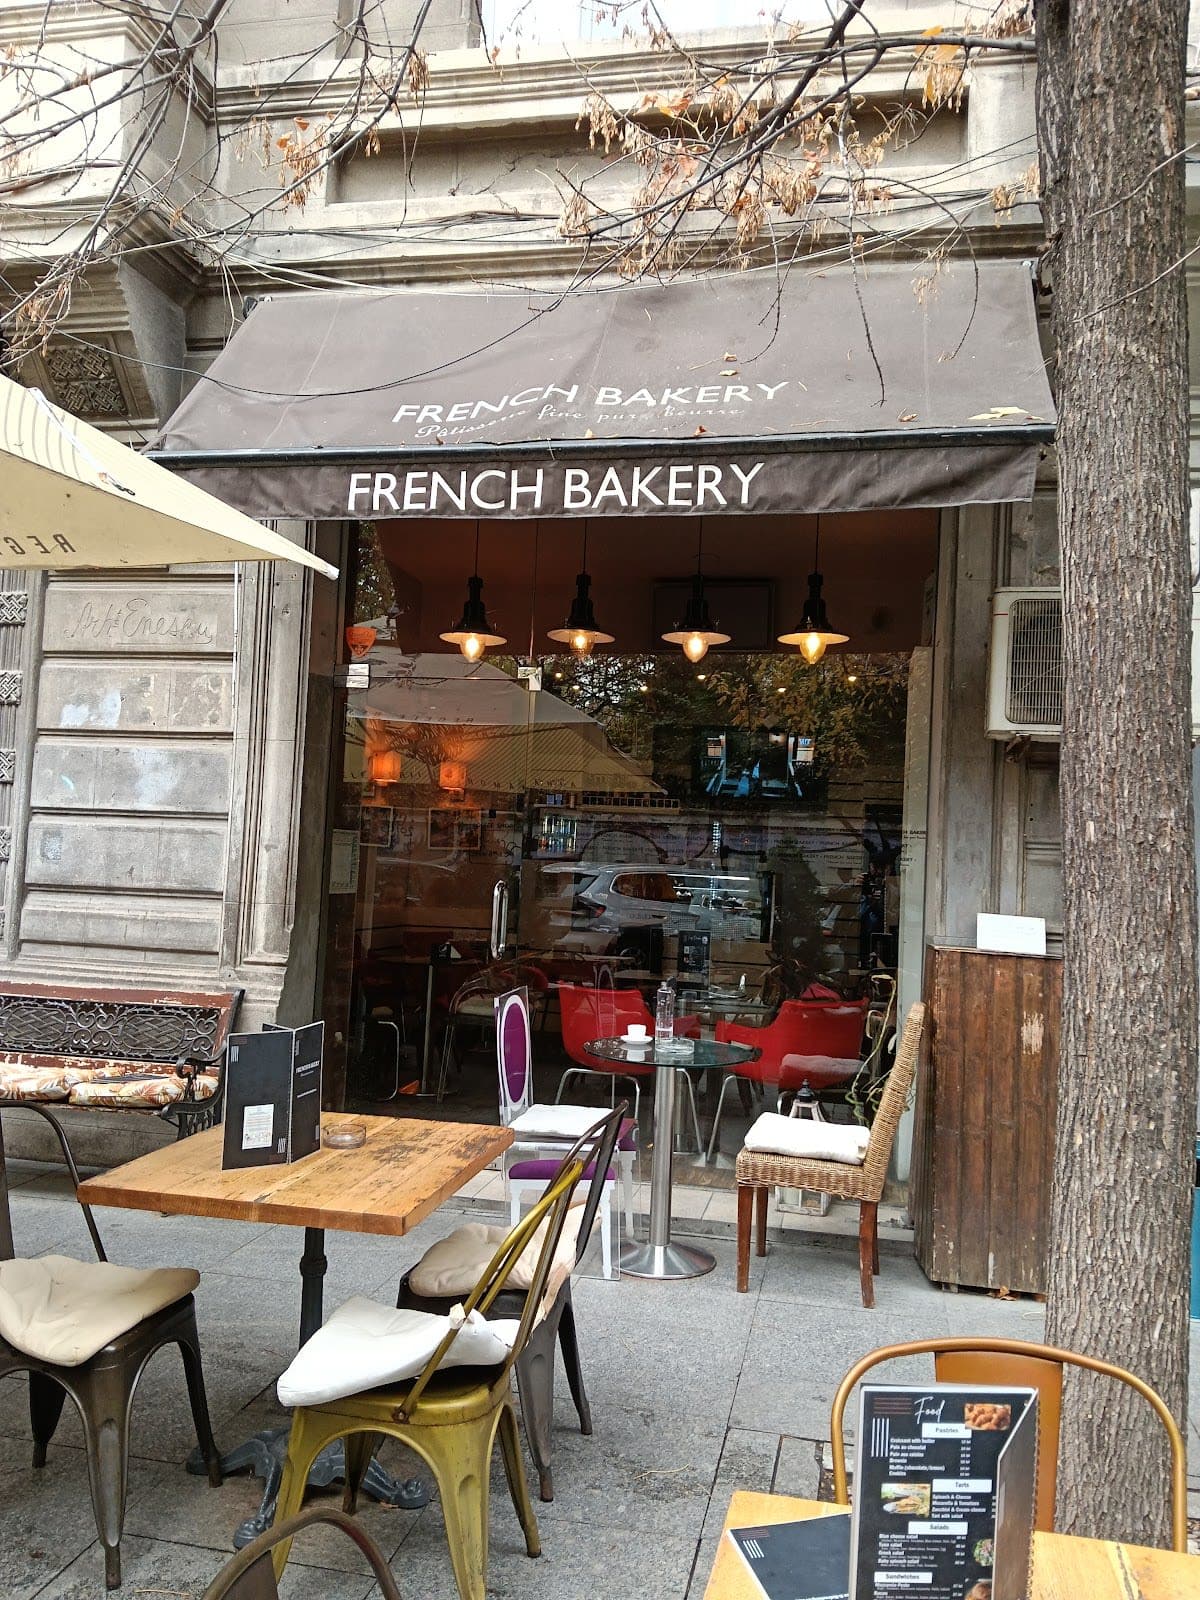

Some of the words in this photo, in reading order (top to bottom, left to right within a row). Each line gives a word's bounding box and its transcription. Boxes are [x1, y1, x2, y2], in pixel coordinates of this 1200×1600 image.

[391, 383, 577, 424] FRENCH
[595, 381, 789, 407] BAKERY
[536, 404, 587, 420] fine
[346, 468, 544, 511] FRENCH
[563, 462, 766, 509] BAKERY
[914, 1396, 946, 1424] Food
